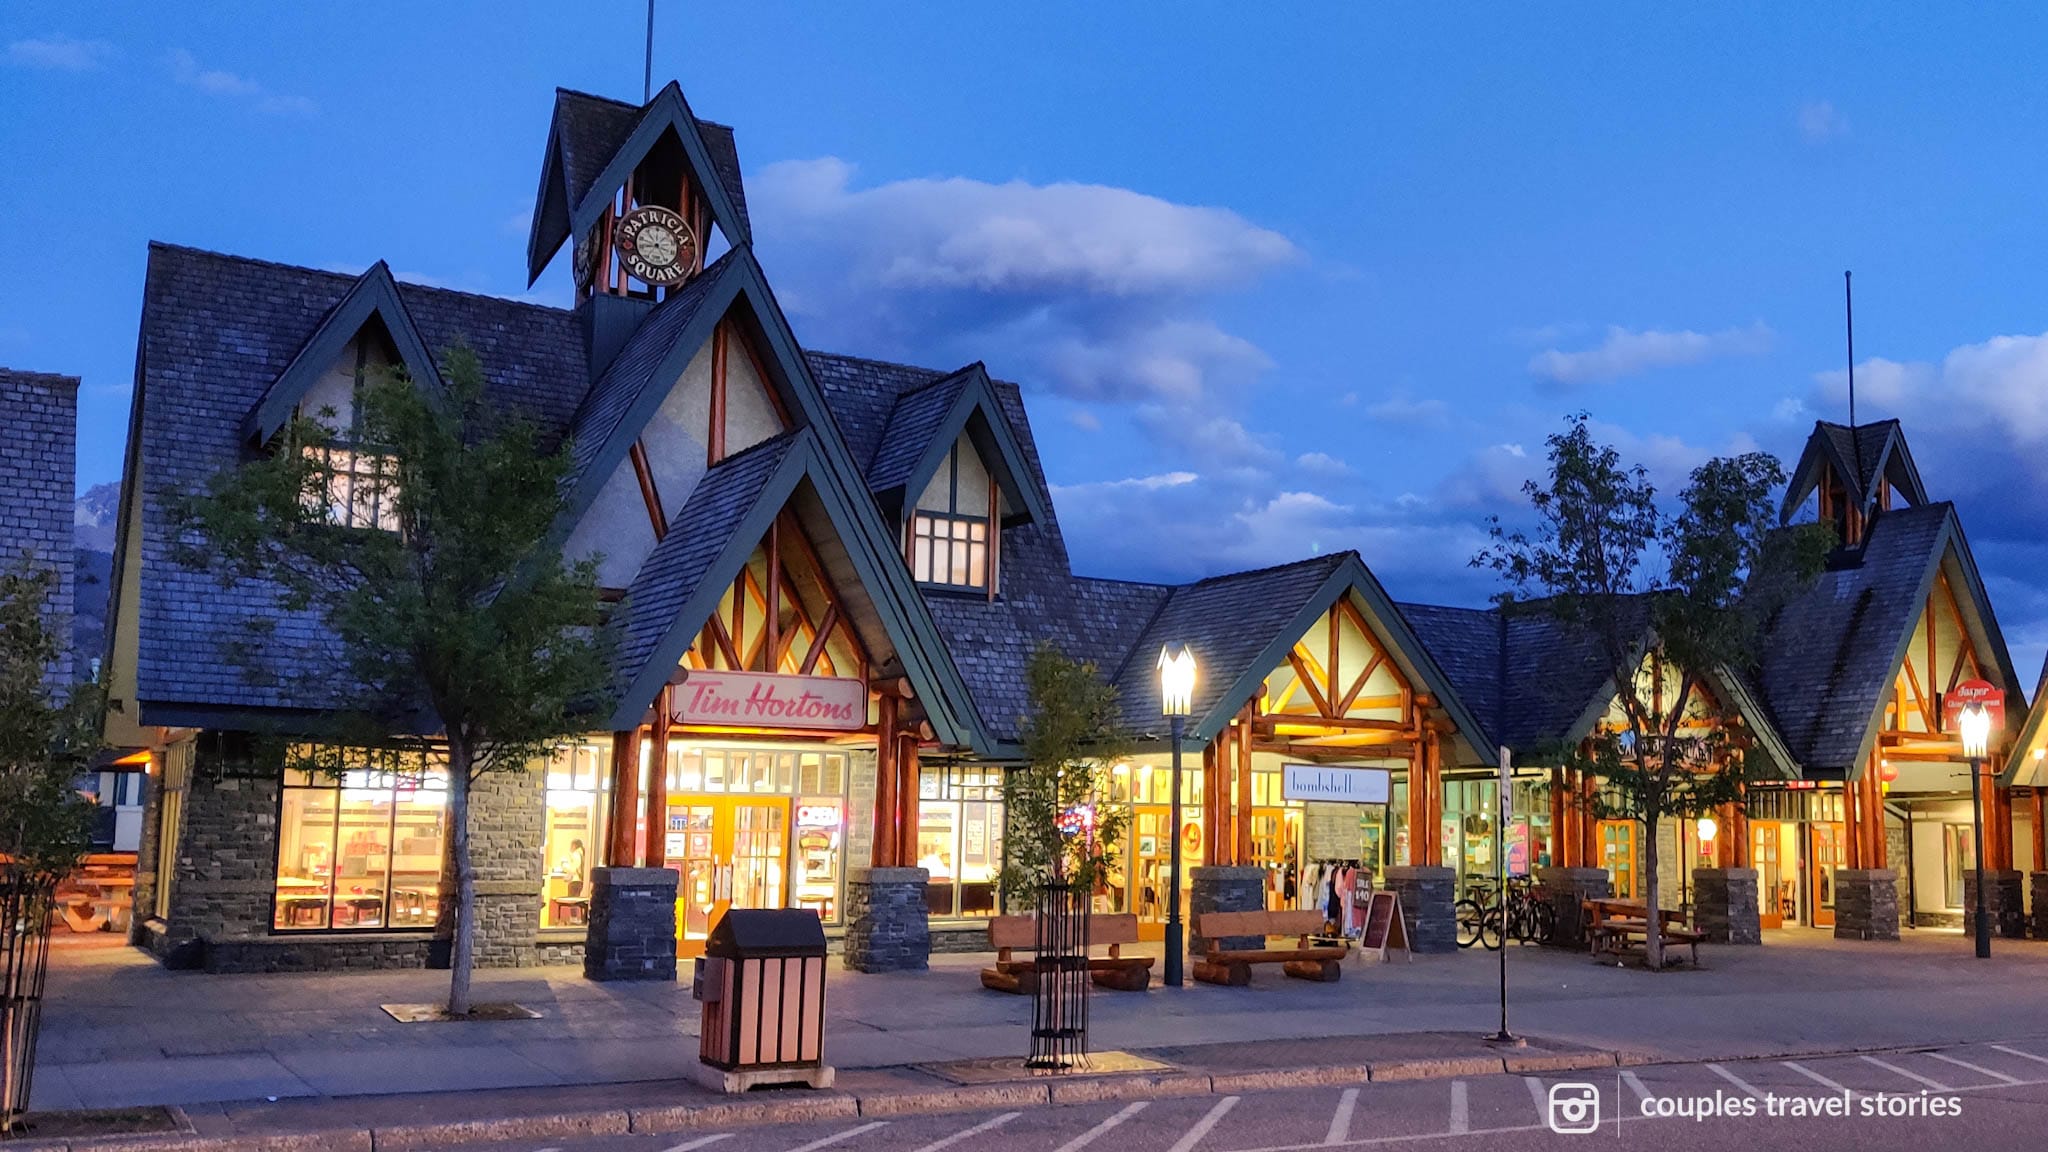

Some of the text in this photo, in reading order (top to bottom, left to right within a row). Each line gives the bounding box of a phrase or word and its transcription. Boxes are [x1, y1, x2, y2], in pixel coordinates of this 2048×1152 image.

[624, 211, 689, 245] PATRICIA
[627, 254, 684, 281] SQUARE
[686, 681, 853, 721] Tim Hortons
[1957, 686, 1989, 699] Jasper
[1292, 770, 1352, 793] bombshell
